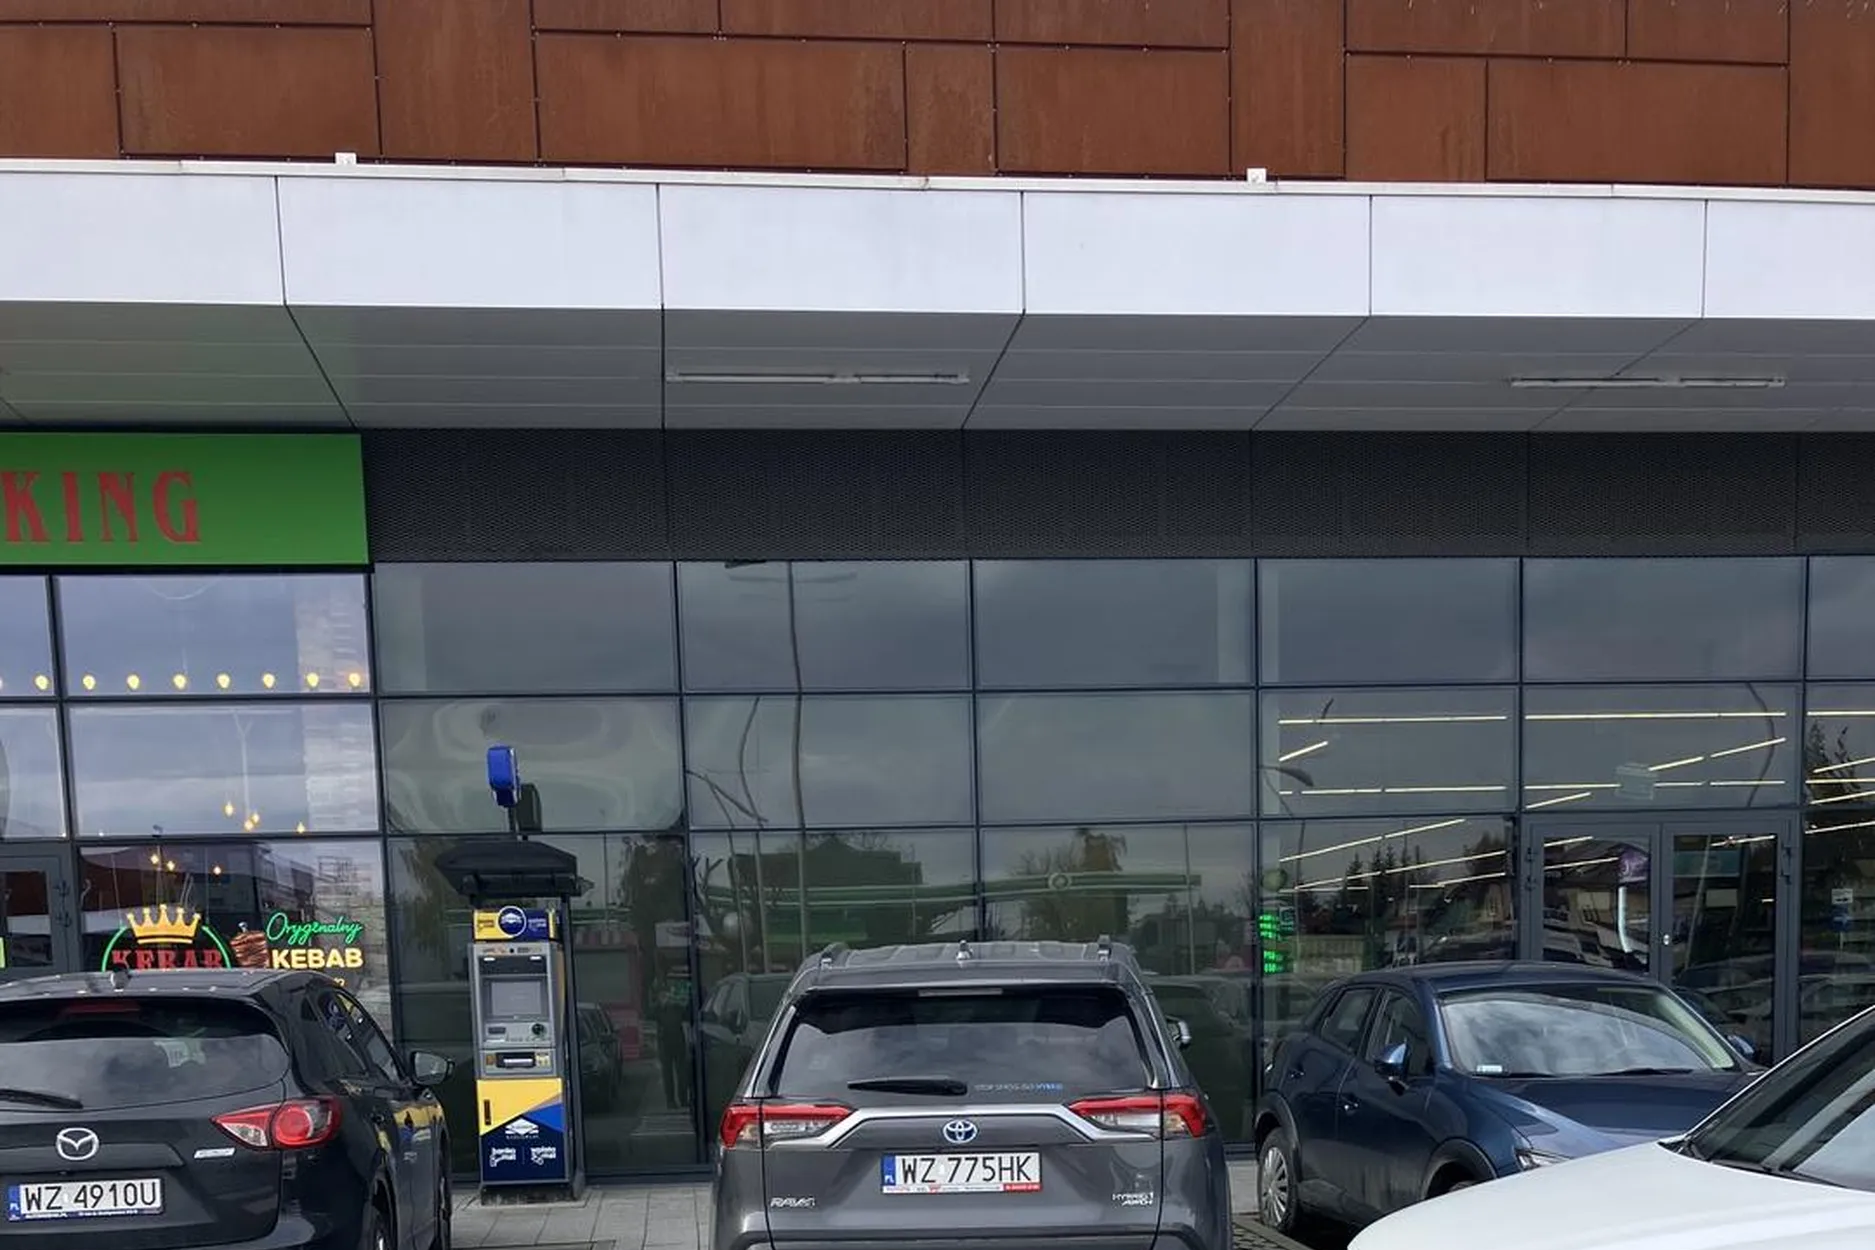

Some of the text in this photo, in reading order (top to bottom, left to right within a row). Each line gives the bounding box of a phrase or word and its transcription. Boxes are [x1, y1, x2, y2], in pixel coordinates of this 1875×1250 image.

[1, 471, 201, 543] KING
[271, 948, 364, 969] KEBAB
[902, 1156, 1031, 1183] WZ 775HK
[25, 1182, 156, 1211] WZ 4910U
